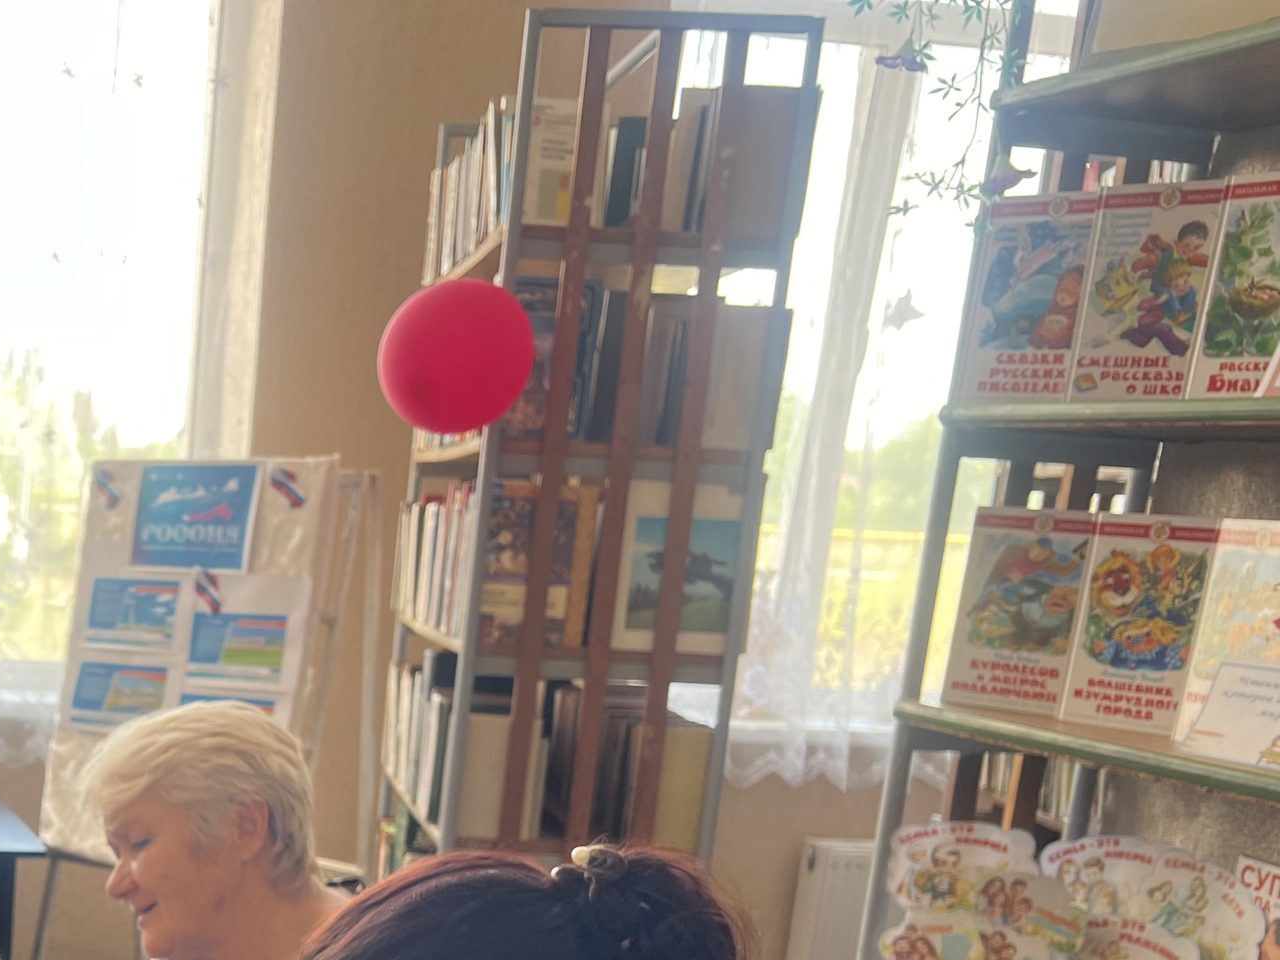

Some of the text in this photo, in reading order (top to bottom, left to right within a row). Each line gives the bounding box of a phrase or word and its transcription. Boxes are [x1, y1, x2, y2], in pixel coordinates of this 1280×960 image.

[996, 353, 1065, 366] СКАЗКИ
[1077, 355, 1170, 369] СМЕШНЫЕ
[989, 367, 1066, 379] РУССКИХ
[1087, 677, 1174, 698] ВОЛШЕБНИК
[1095, 704, 1154, 721] ГОРОДА
